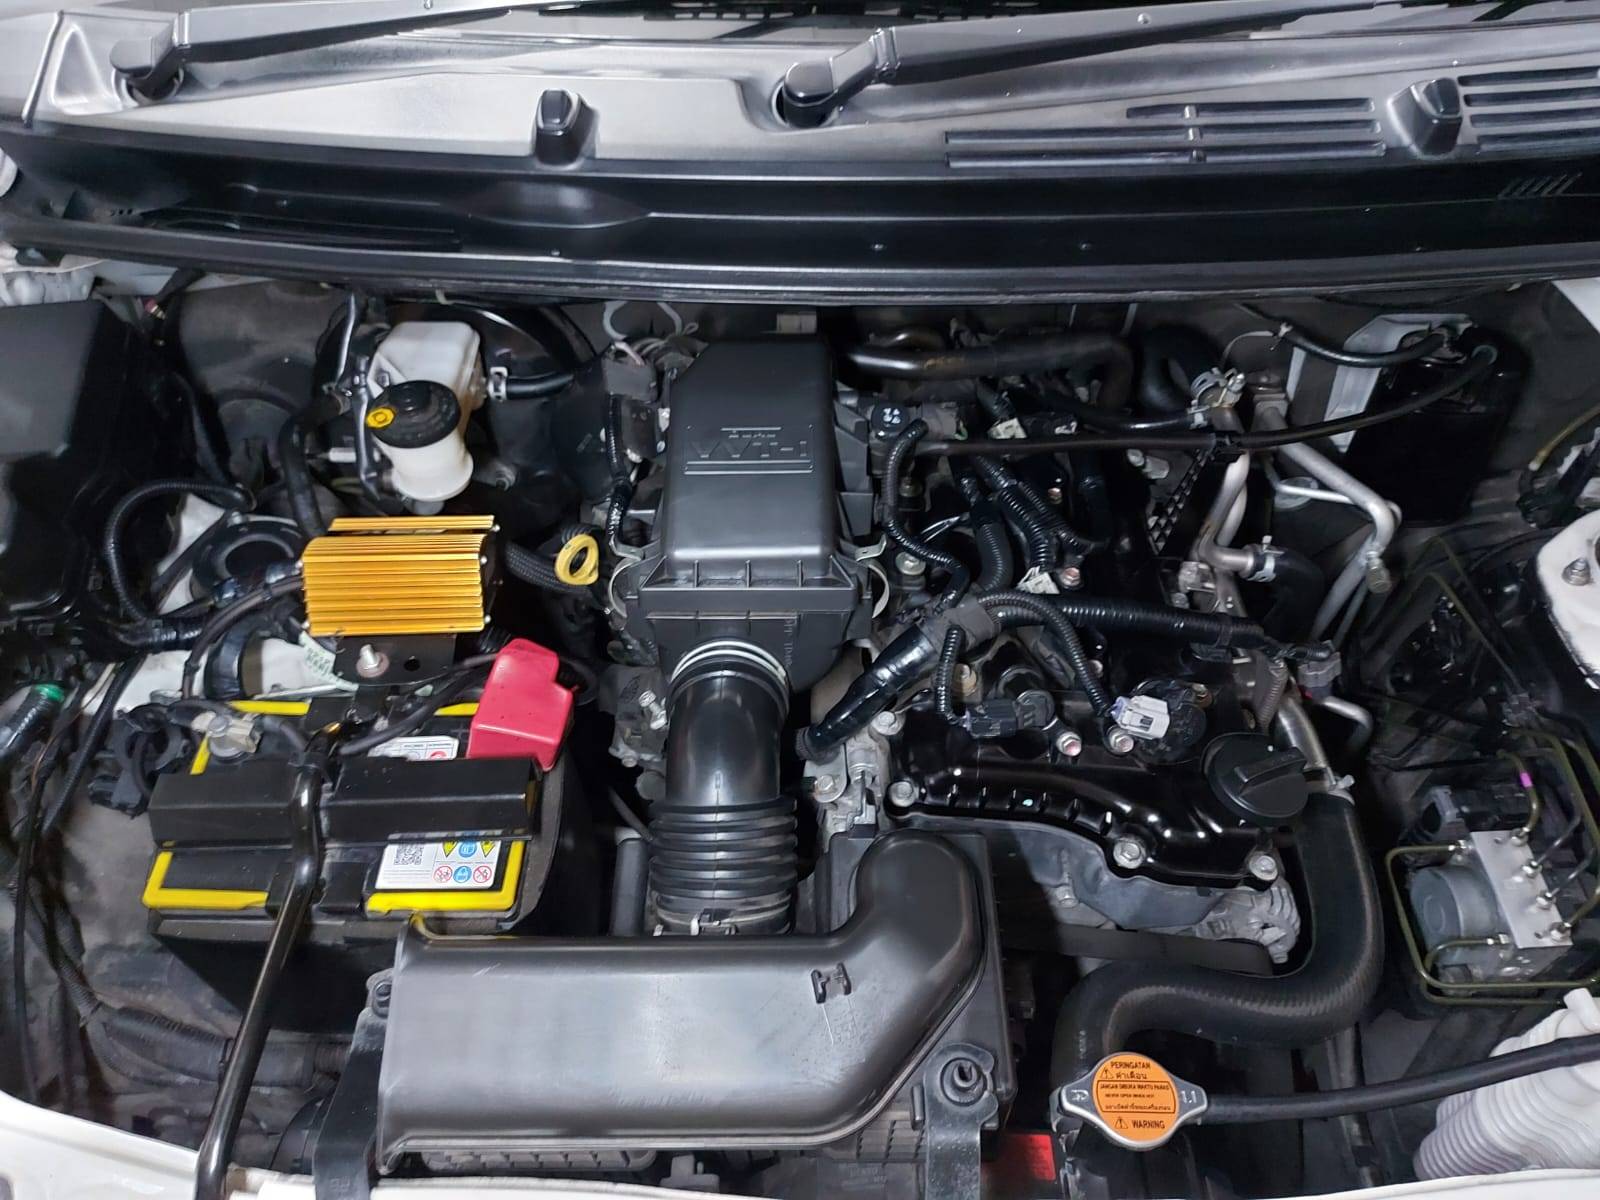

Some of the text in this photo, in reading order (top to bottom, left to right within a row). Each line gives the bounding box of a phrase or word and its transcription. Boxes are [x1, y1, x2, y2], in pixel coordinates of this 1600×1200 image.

[1110, 1061, 1151, 1069] PERINGATAN
[1180, 1090, 1198, 1104] 1.1
[1132, 1119, 1166, 1129] WARNING
